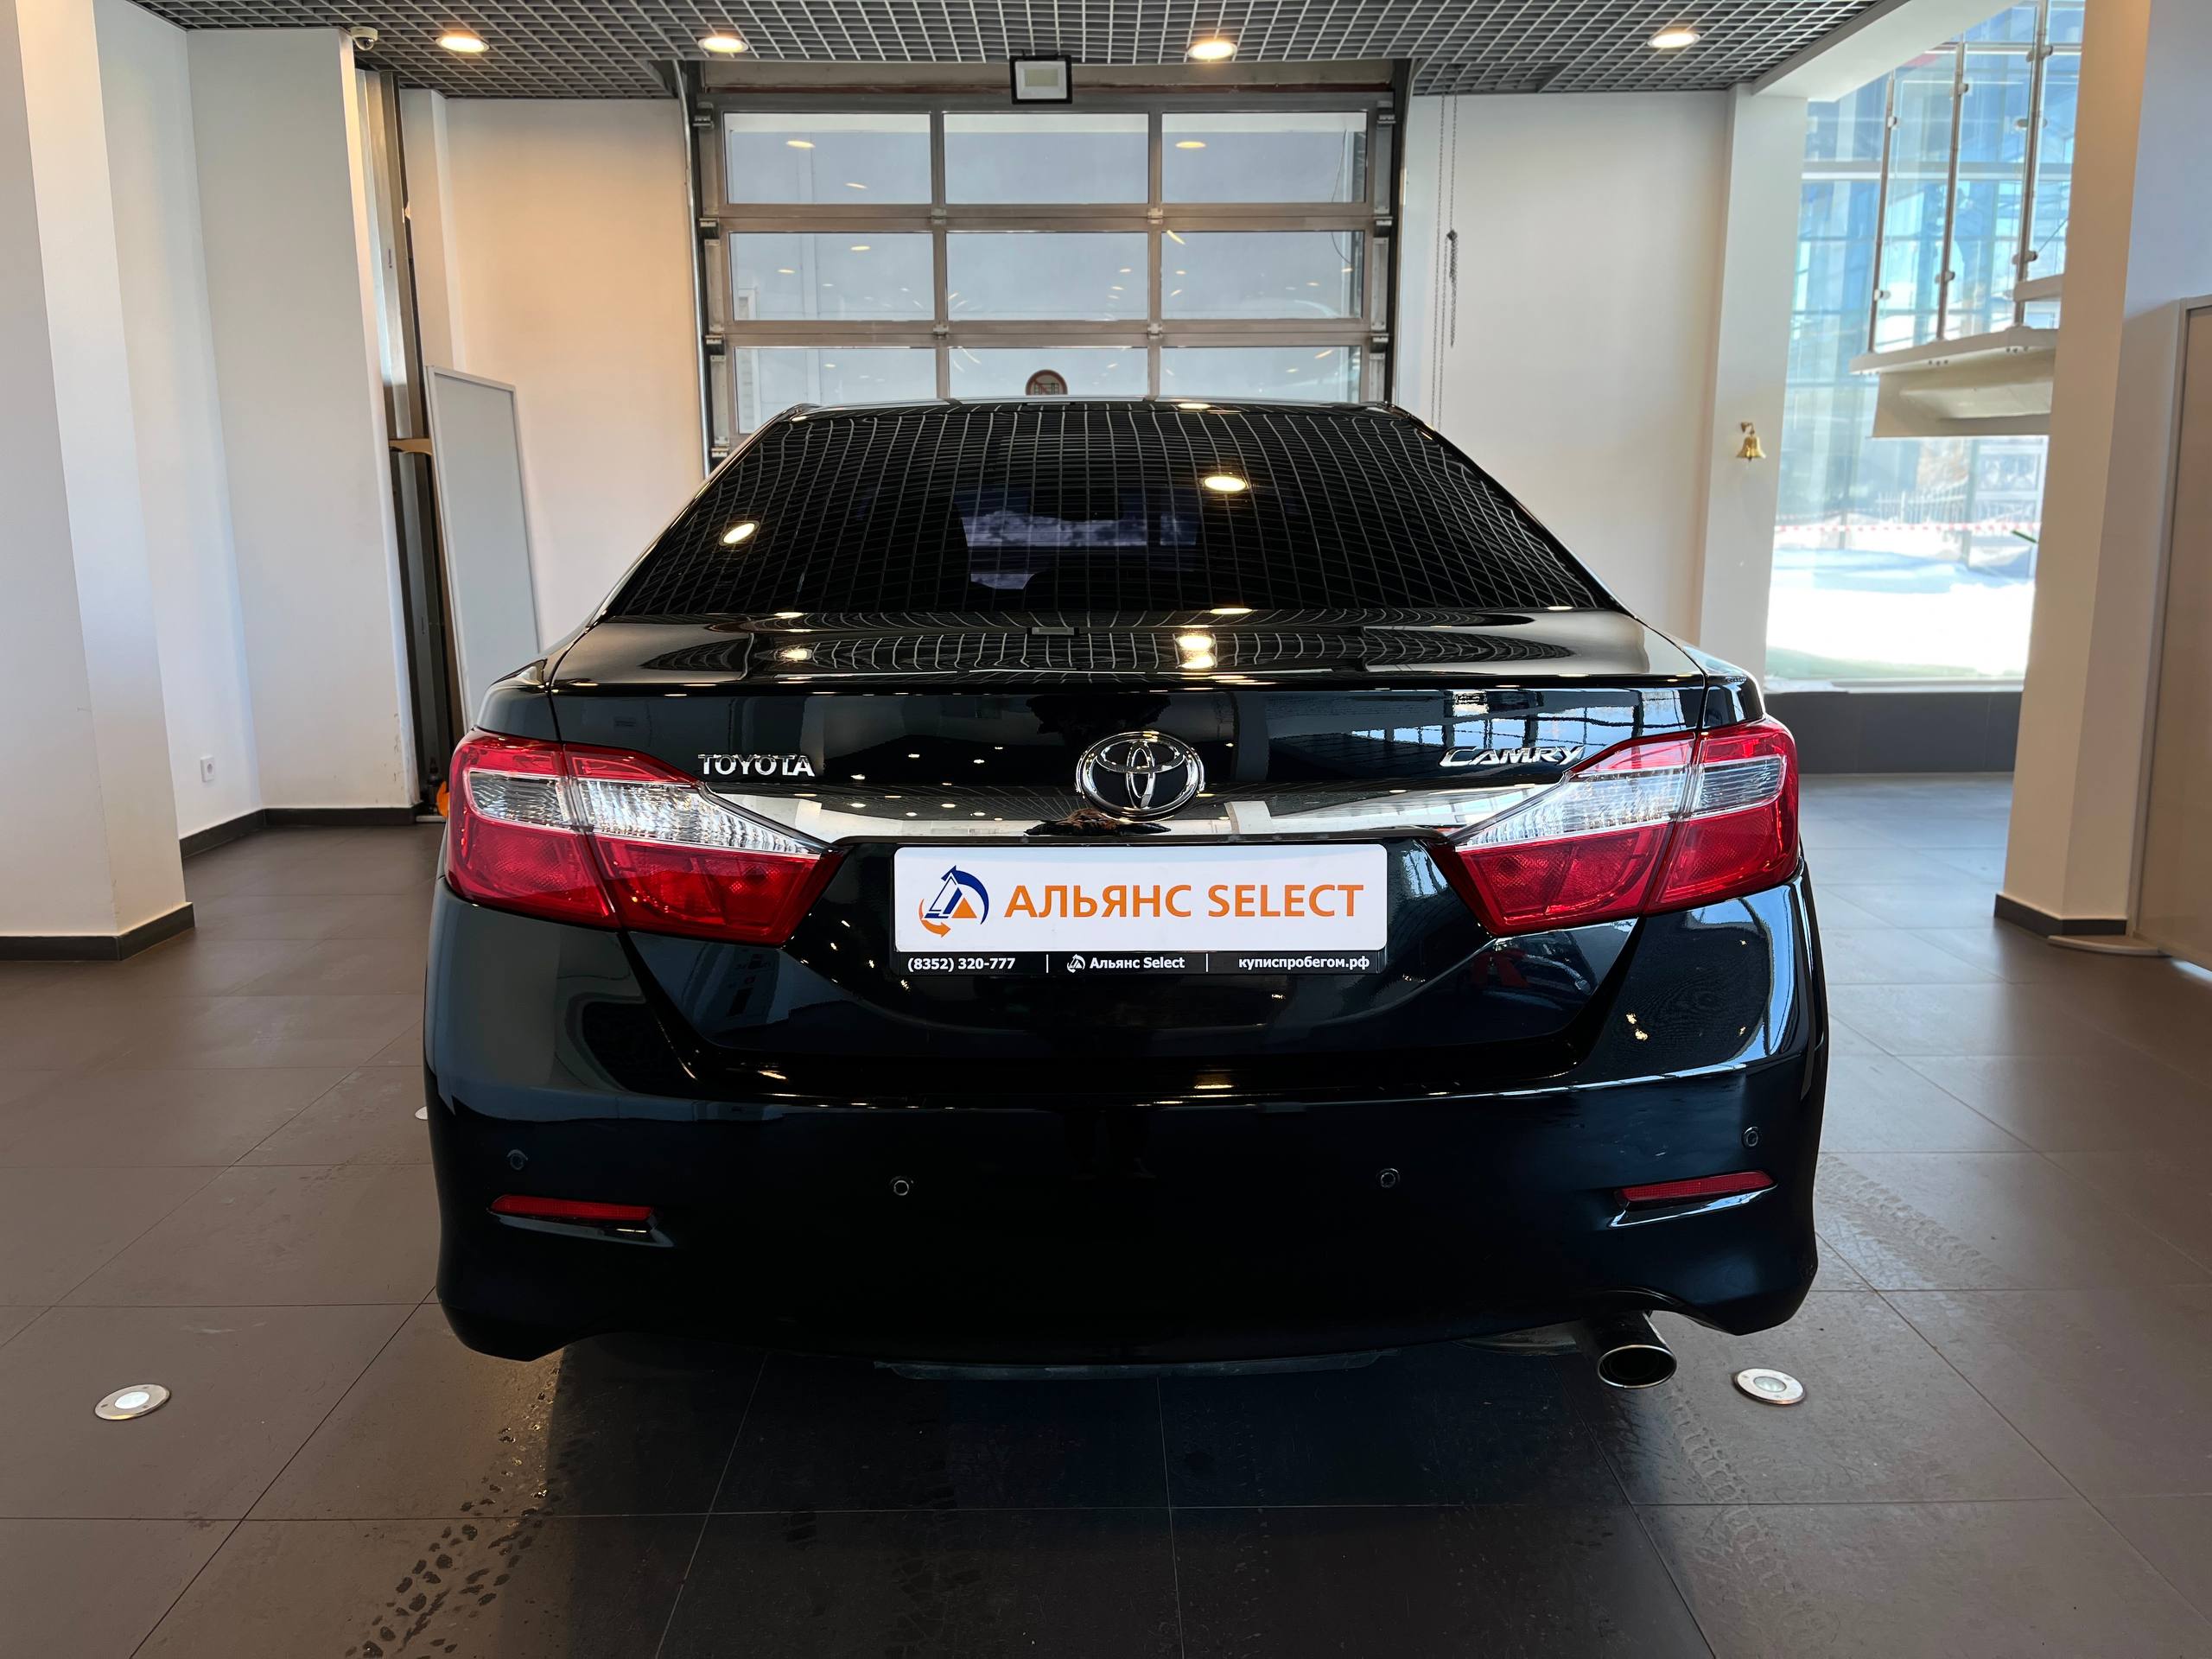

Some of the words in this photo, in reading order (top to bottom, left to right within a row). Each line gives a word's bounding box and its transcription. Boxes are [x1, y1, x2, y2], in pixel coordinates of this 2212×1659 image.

[697, 753, 816, 778] TOYOTA
[1438, 745, 1586, 767] CAMRY
[1004, 884, 1192, 918] АЛЬЯНС
[1208, 884, 1364, 918] SELECT
[907, 957, 955, 973] (8352)
[957, 957, 1016, 970] 320-777
[1089, 957, 1141, 969] Альянс
[1143, 957, 1185, 969] Select
[1238, 956, 1370, 970] куписпробегом.рф
